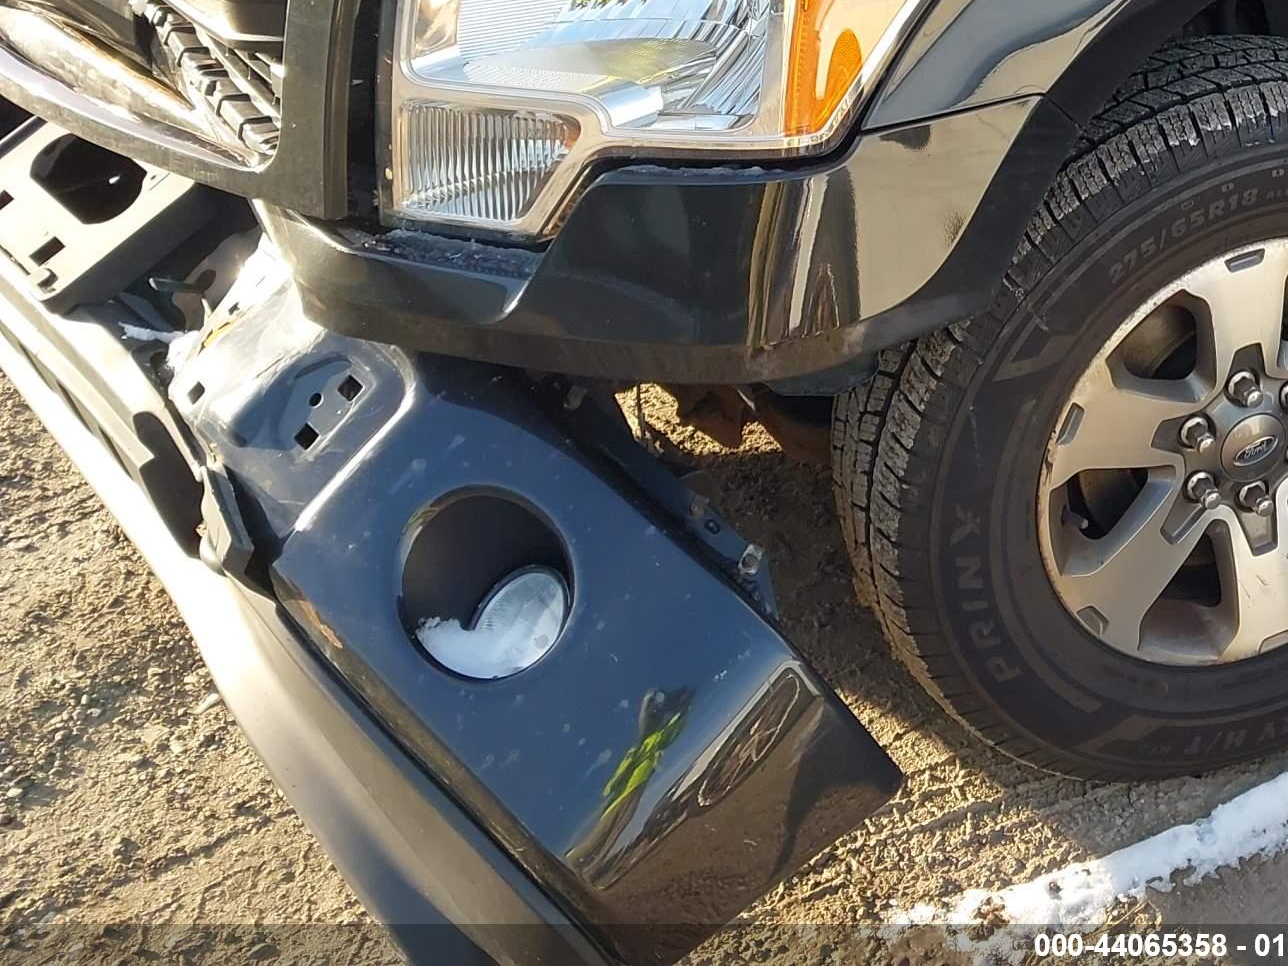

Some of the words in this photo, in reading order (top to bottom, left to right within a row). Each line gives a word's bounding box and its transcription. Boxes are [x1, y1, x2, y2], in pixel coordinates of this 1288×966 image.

[1108, 187, 1259, 284] 275/65R18
[1243, 440, 1268, 459] Ford
[950, 502, 1022, 683] PRINX
